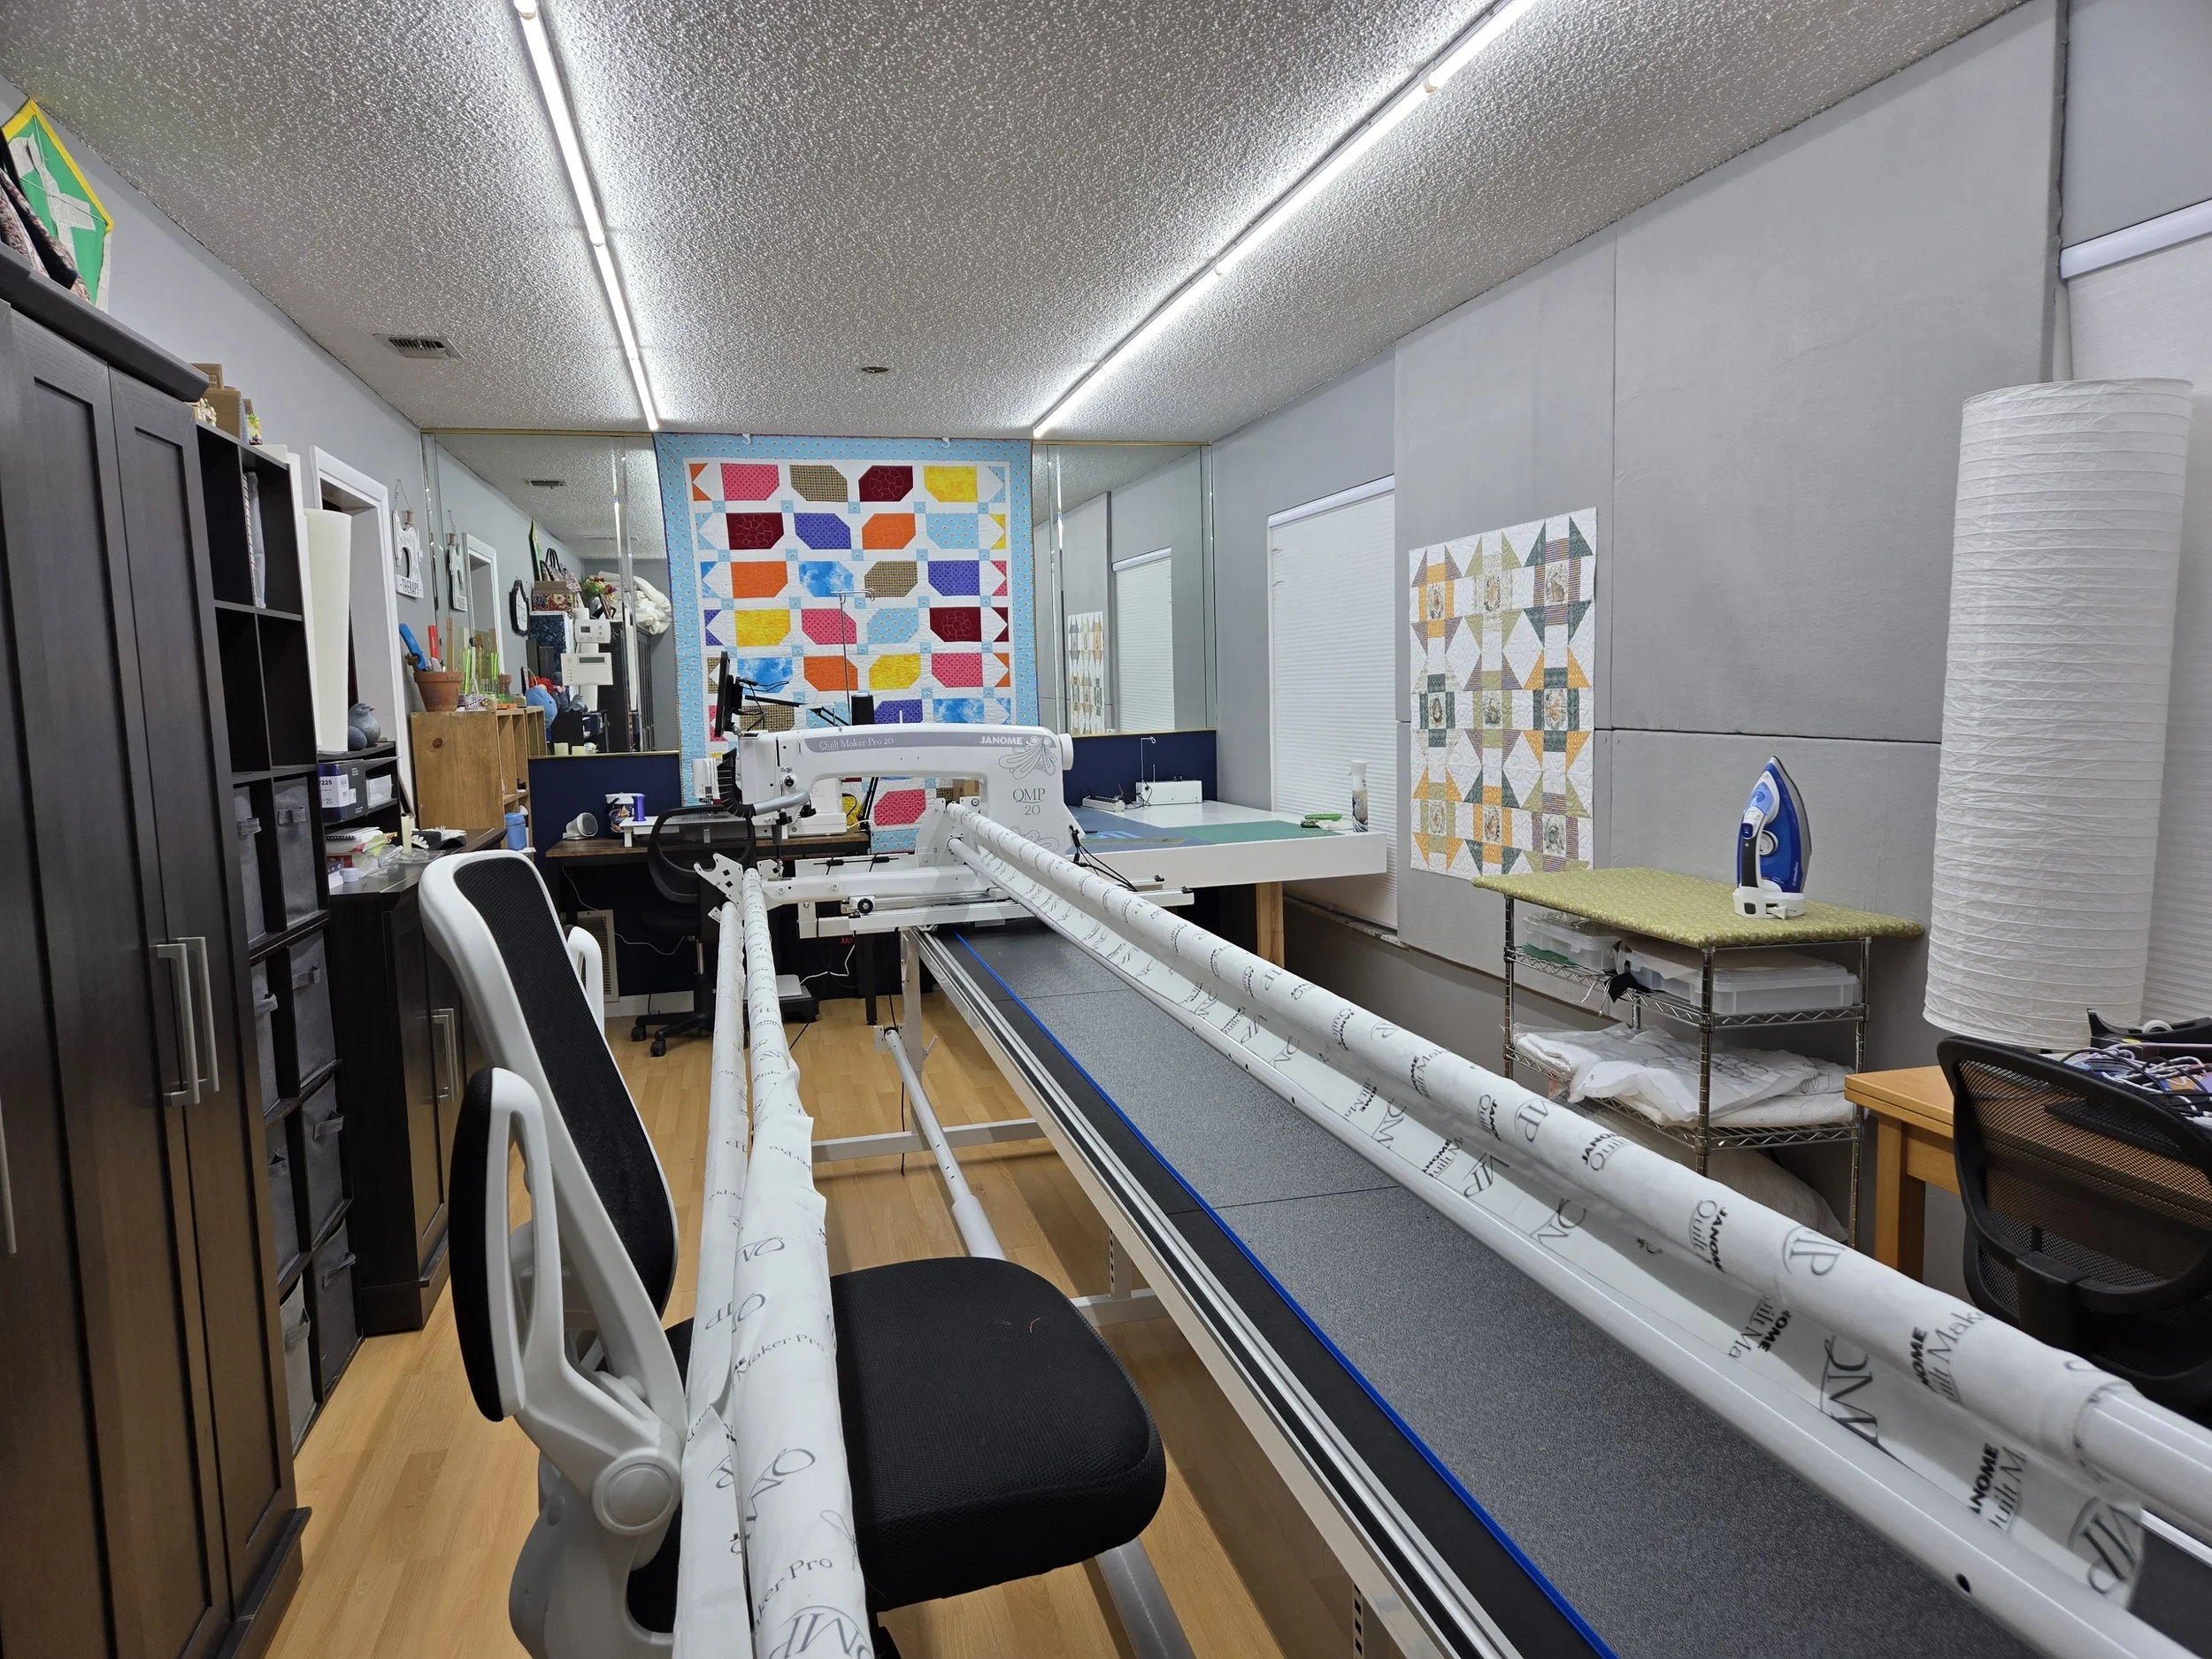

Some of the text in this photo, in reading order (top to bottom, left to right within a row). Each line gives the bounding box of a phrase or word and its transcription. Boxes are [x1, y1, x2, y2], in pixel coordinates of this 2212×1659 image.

[819, 741, 839, 750] Quilt
[841, 739, 866, 749] Maker
[868, 737, 882, 746] Pro
[1012, 787, 1046, 803] QMP
[1025, 804, 1041, 816] 20
[788, 1557, 833, 1580] Pro
